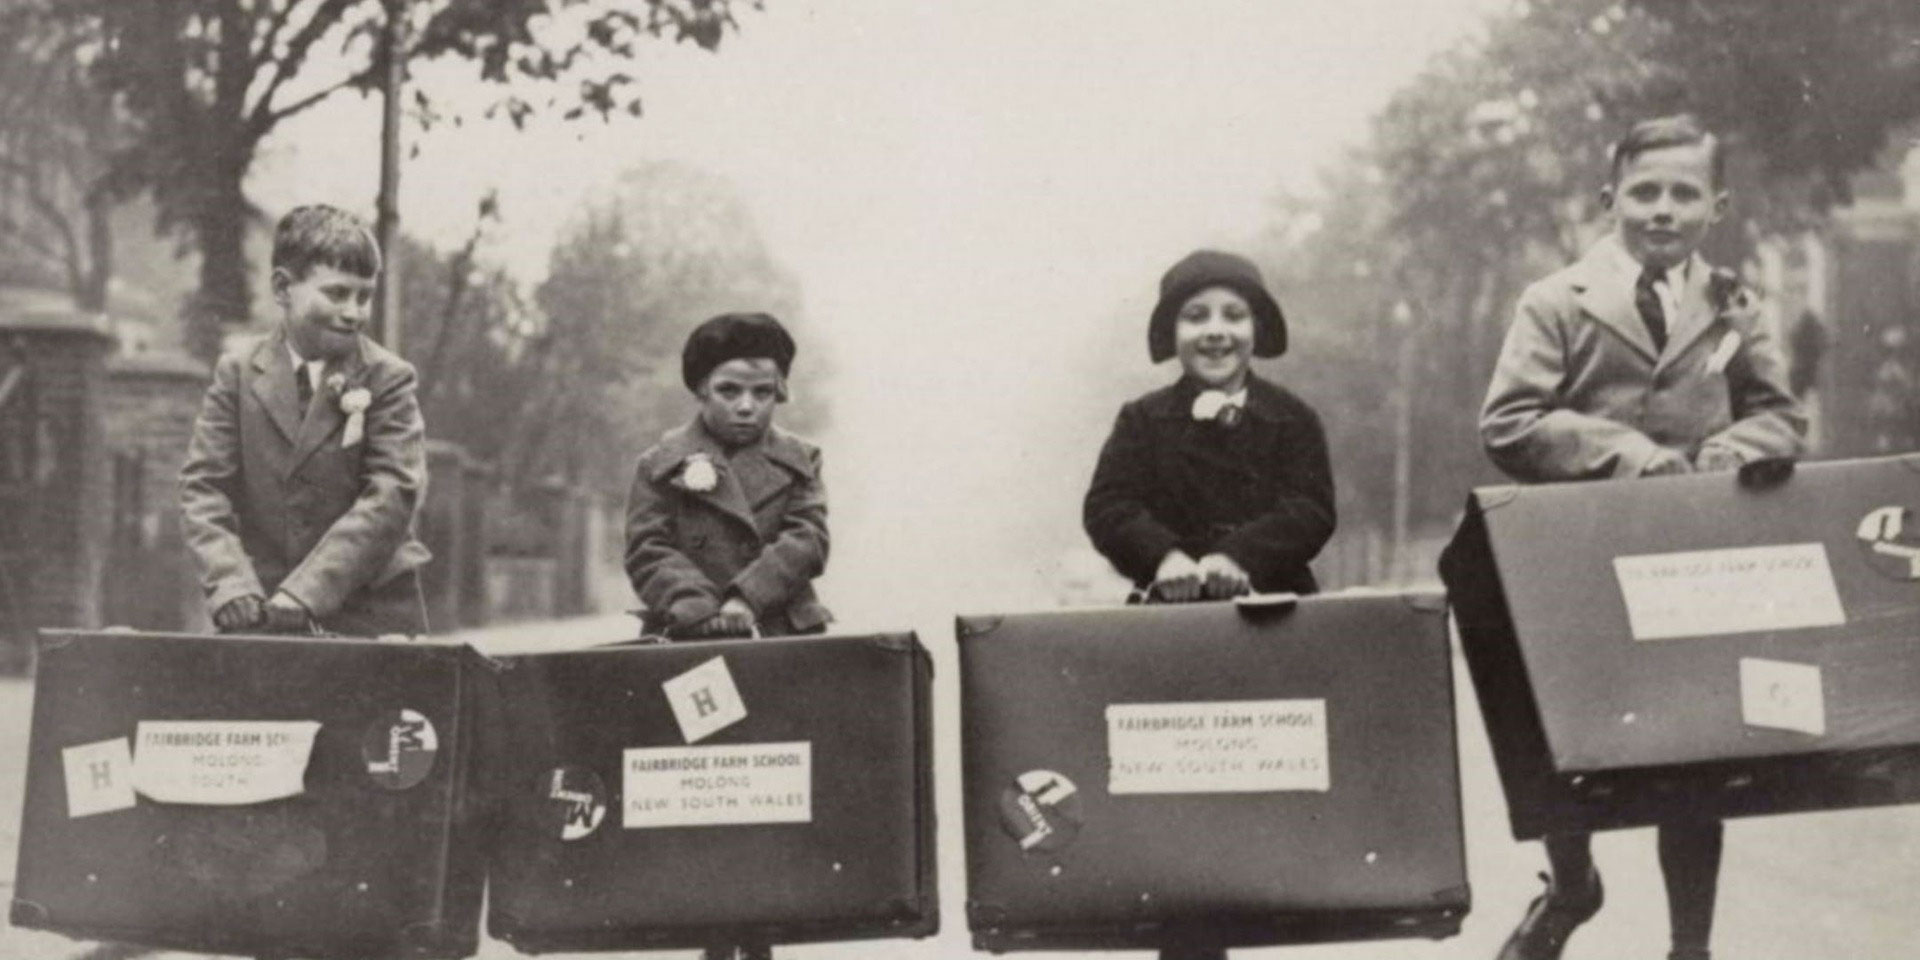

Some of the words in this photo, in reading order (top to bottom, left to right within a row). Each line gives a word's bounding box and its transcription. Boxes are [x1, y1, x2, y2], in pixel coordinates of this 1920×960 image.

[690, 685, 719, 718] H
[1117, 716, 1205, 731] FAIRBRIDGE
[1213, 714, 1253, 730] FARM
[1259, 713, 1314, 728] SCHOOL
[226, 732, 261, 747] FARM
[631, 757, 708, 772] FAIRBRIDGE
[713, 755, 748, 770] FARM
[752, 753, 801, 768] SCHOOL
[88, 759, 113, 791] H
[680, 776, 752, 791] MOLONG
[631, 799, 669, 812] NEW
[681, 796, 739, 810] SOUTH
[751, 793, 804, 807] WALES
